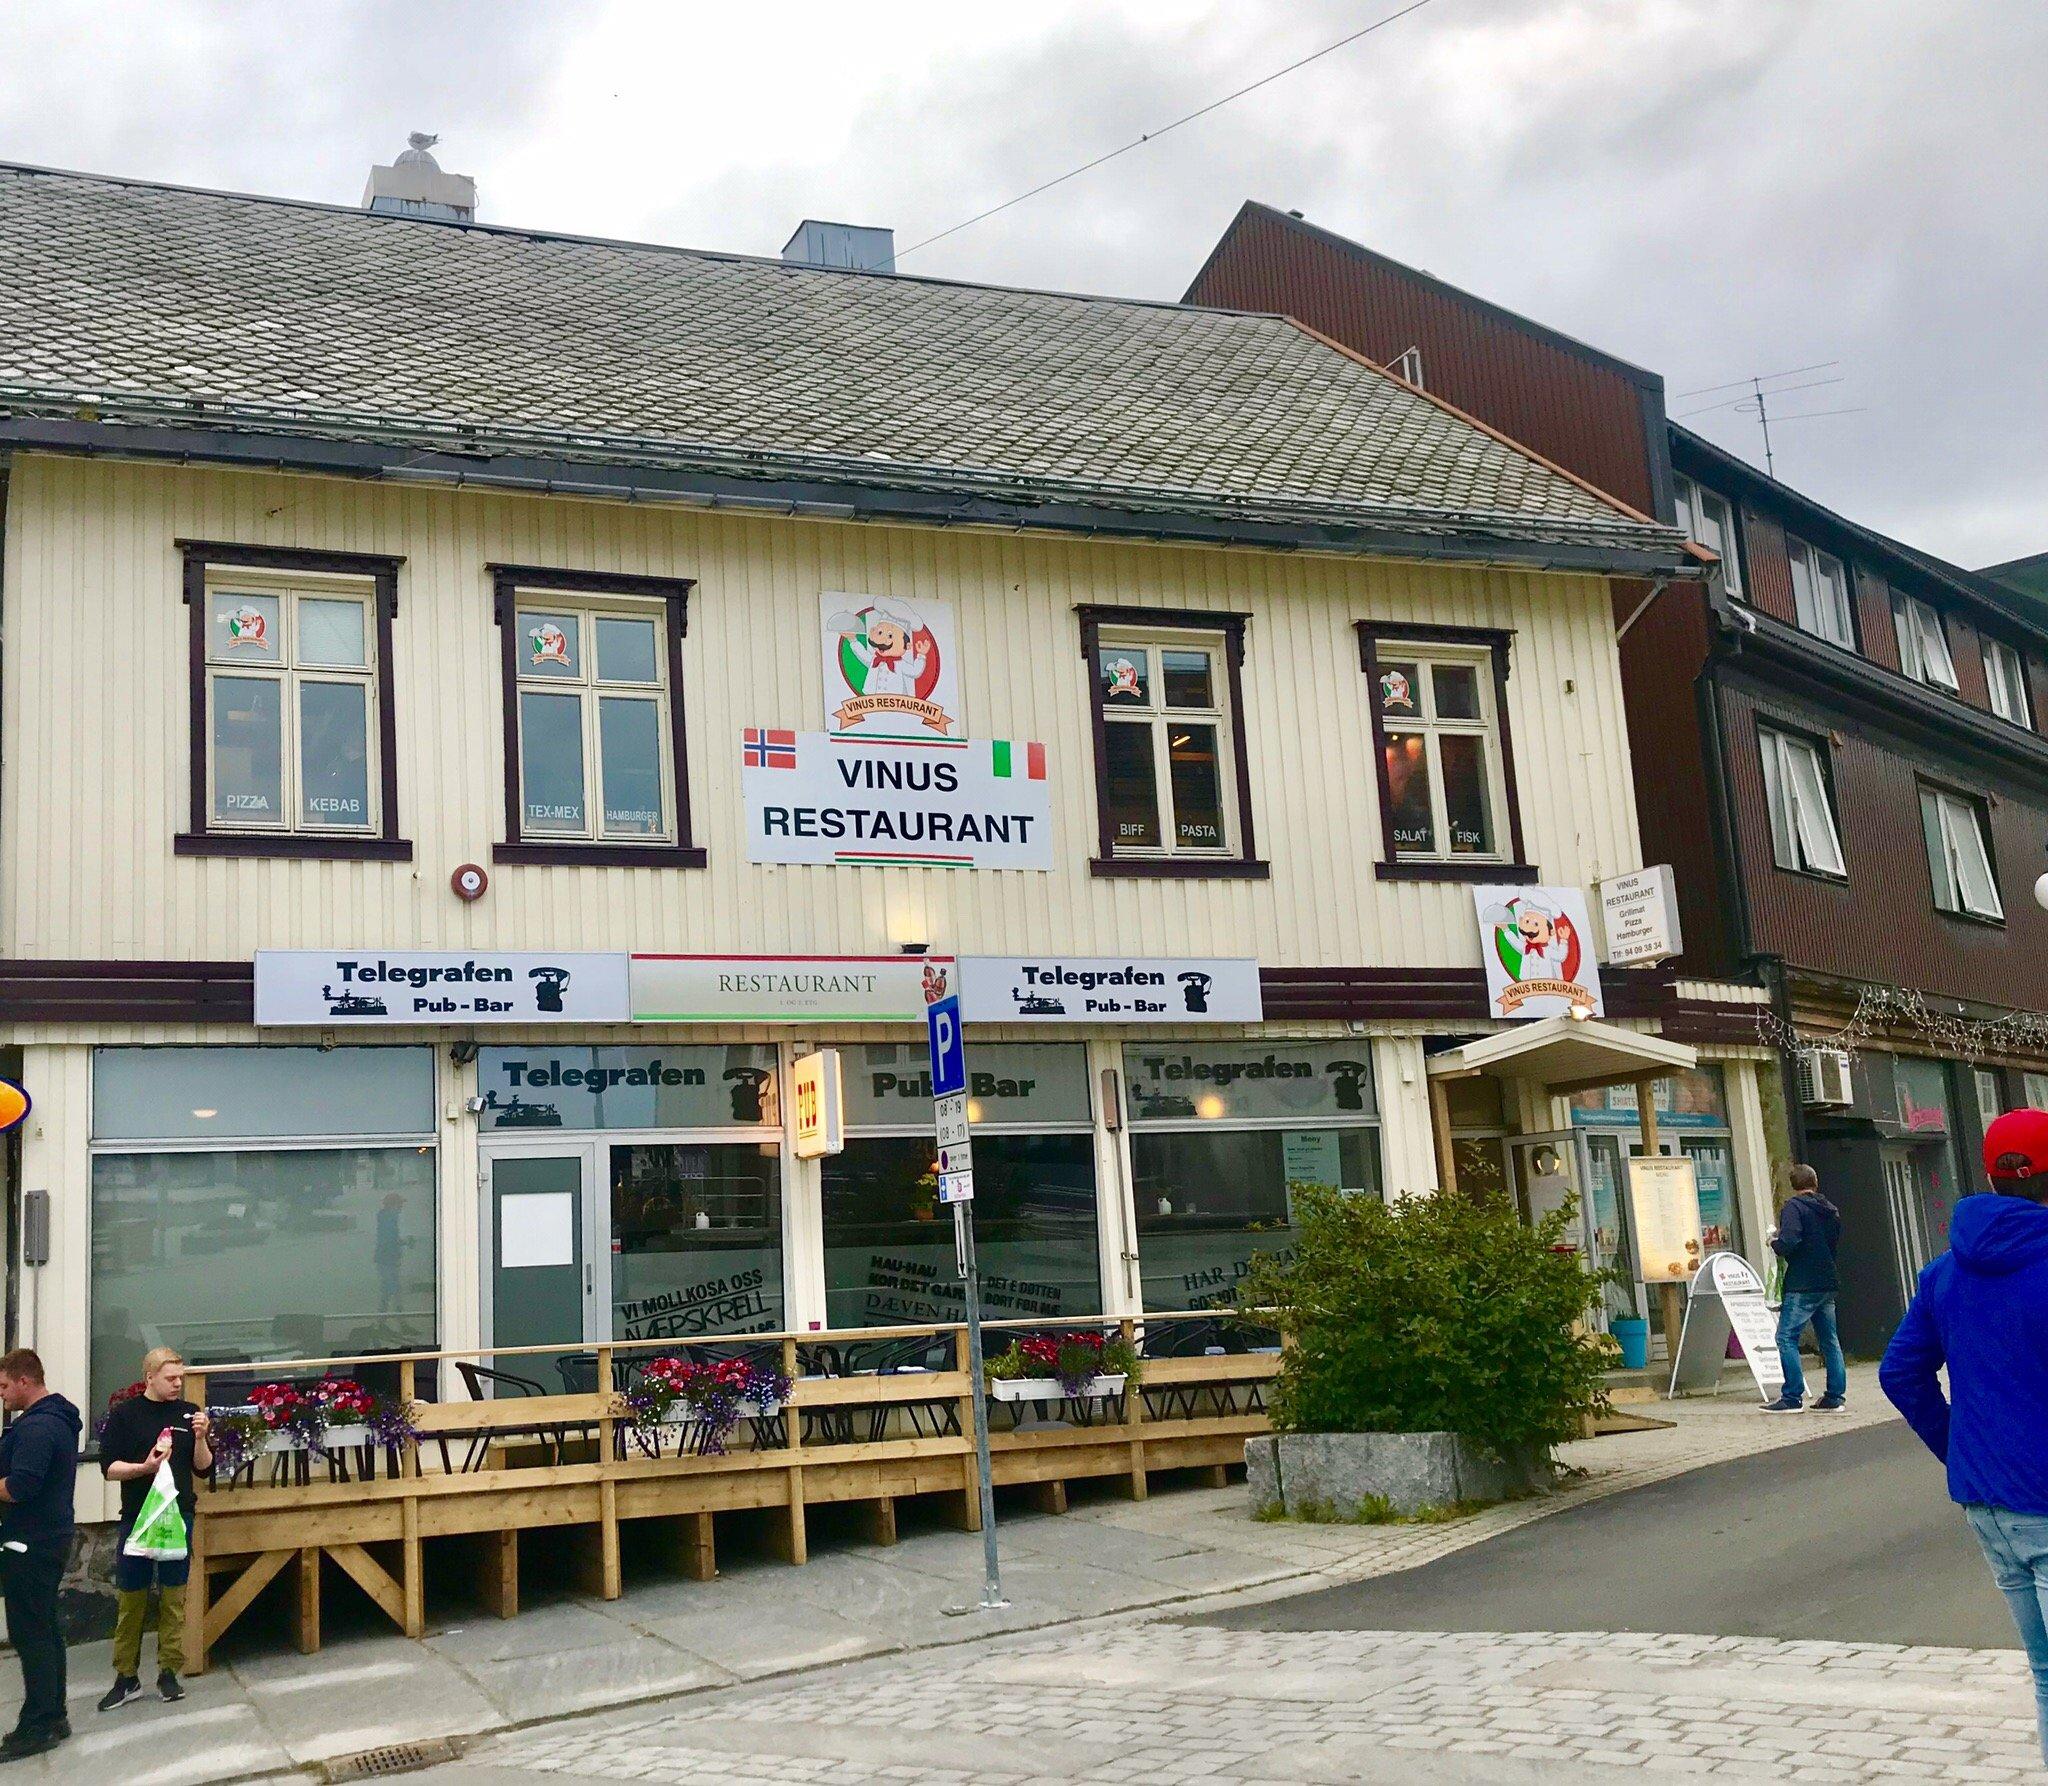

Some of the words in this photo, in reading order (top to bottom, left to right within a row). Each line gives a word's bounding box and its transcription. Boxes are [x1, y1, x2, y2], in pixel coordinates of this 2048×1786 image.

[846, 698, 875, 713] VINUS
[876, 698, 939, 718] RESTAURANT
[837, 759, 959, 792] VINUS
[226, 794, 269, 811] PIZZA
[309, 798, 360, 814] KEBAB
[528, 804, 580, 821] TEX-MEX
[606, 809, 659, 823] HAMBURGER
[763, 806, 1034, 844] RESTAURANT
[1119, 823, 1145, 837] BIFF
[1181, 824, 1217, 838] PASTA
[1393, 828, 1428, 842] SALAT
[1456, 831, 1481, 844] FISK
[1616, 877, 1639, 891] VINUS
[1606, 887, 1655, 907] RESTAURANT
[1619, 905, 1646, 919] Grillmat
[1624, 918, 1643, 928] Pizza
[1616, 926, 1653, 941] Hamburger
[336, 960, 513, 988] Telegrafen
[718, 974, 877, 993] RESTAURANT
[1022, 965, 1165, 991] Telegrafen
[1507, 983, 1531, 998] VINUS
[1531, 982, 1584, 998] RESTAURANT
[936, 1011, 953, 1082] P
[502, 1059, 706, 1094] Telegrafen
[1143, 1055, 1313, 1086] Telegrafen
[971, 1072, 1036, 1098] Bar
[1183, 1267, 1225, 1290] HAR
[621, 1304, 638, 1320] VI
[642, 1277, 728, 1315] MOLLKOSA
[731, 1269, 763, 1290] OSS
[866, 1294, 940, 1318] DÆVEN
